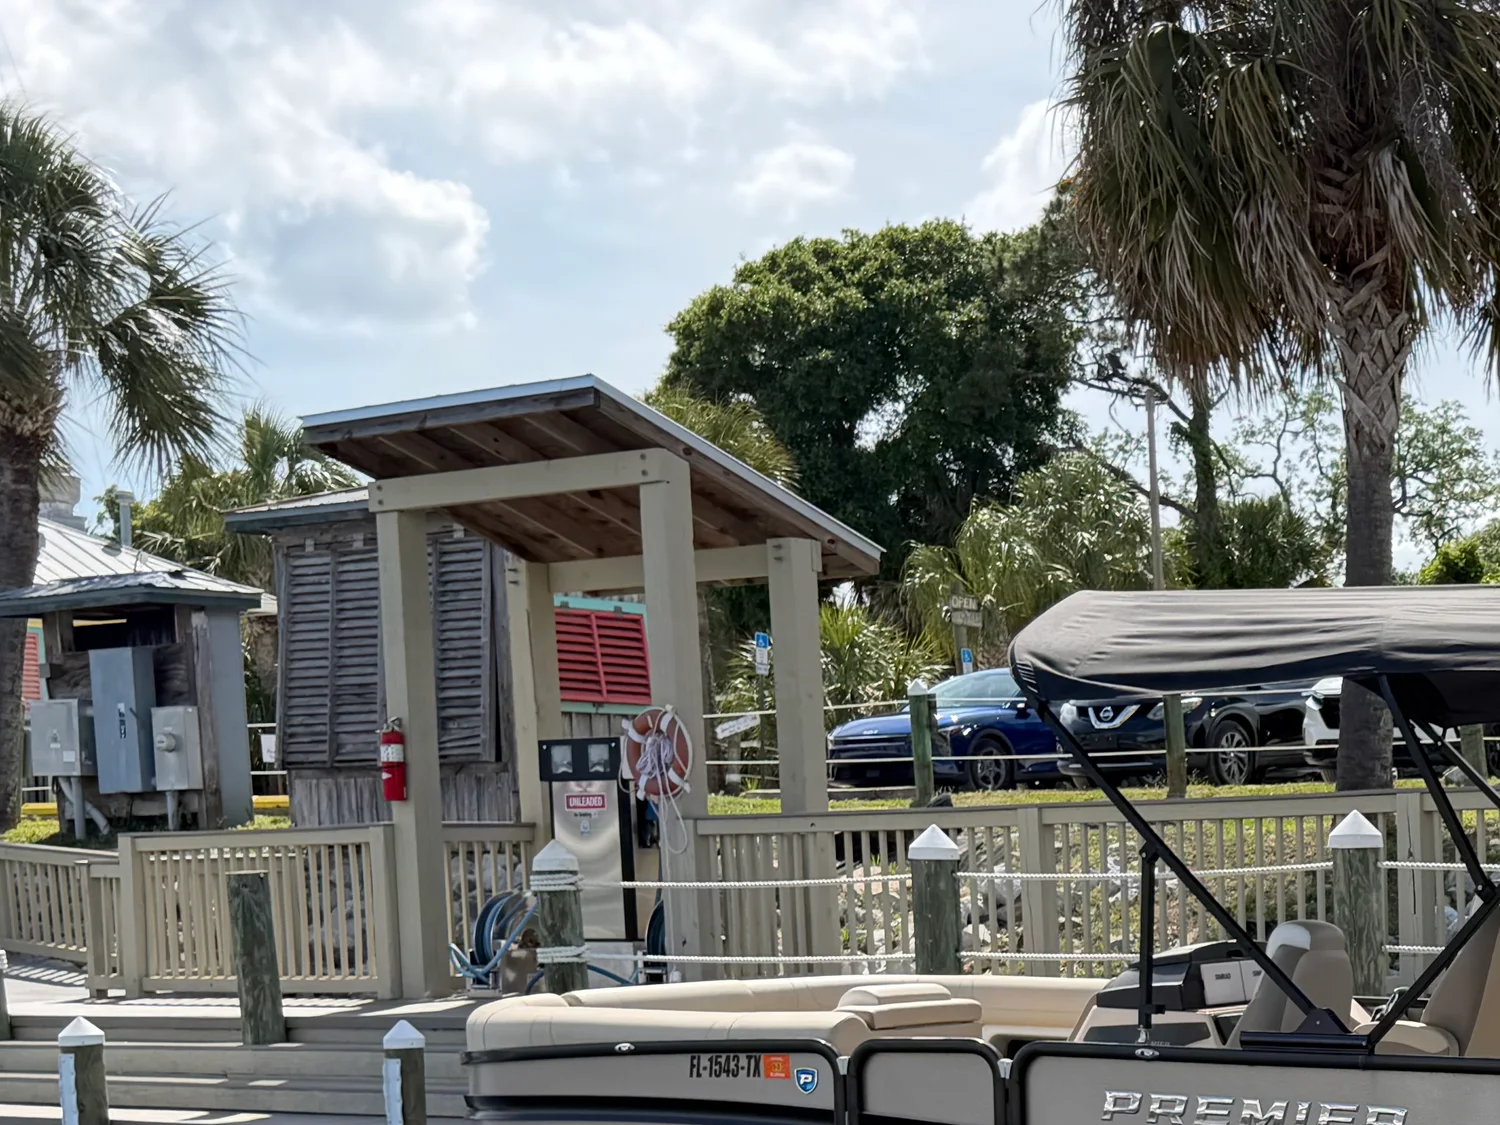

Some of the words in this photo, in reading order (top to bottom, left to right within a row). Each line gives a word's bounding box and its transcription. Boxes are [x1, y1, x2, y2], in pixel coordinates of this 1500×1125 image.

[951, 595, 978, 610] OPEN
[569, 796, 603, 807] UNLEADED
[689, 1054, 763, 1079] FL-1543-TX
